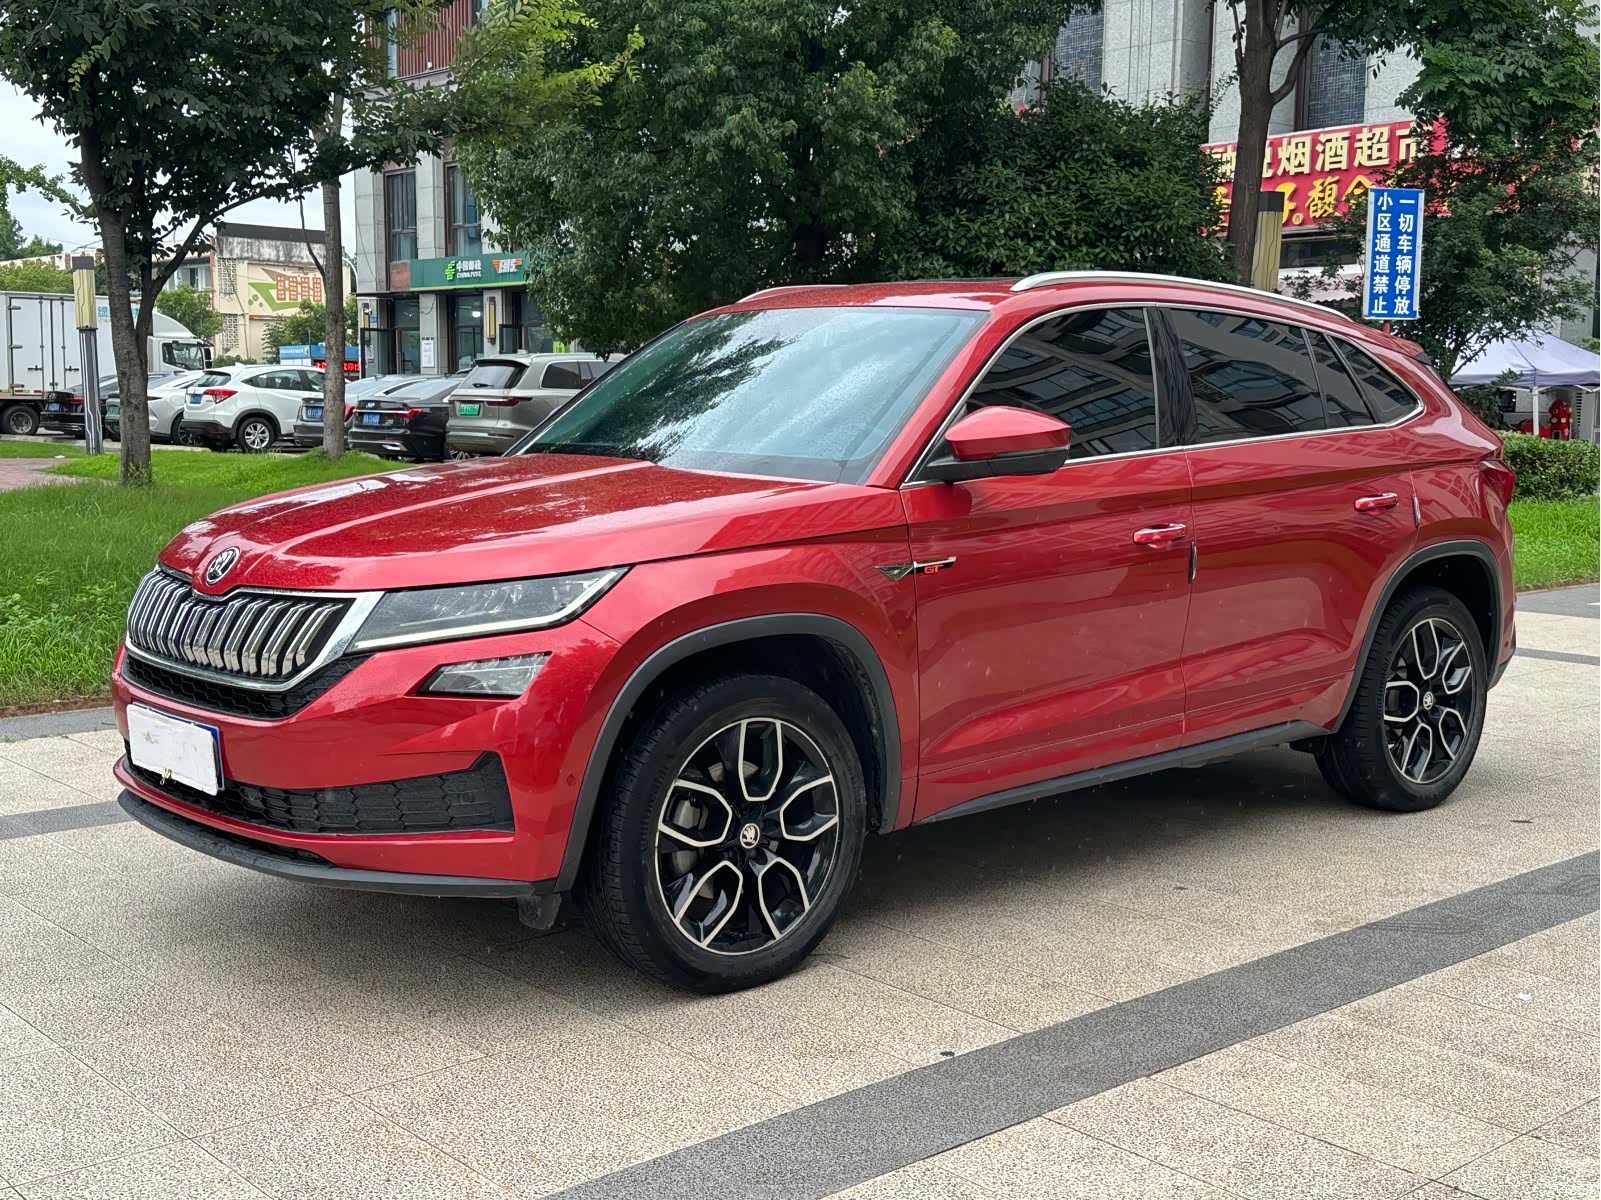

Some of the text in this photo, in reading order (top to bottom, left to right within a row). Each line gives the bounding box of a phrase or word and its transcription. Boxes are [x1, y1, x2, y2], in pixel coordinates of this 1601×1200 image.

[1371, 192, 1393, 314] 小区通道禁止
[1393, 199, 1415, 315] 一切车辆停放
[924, 564, 943, 574] GT
